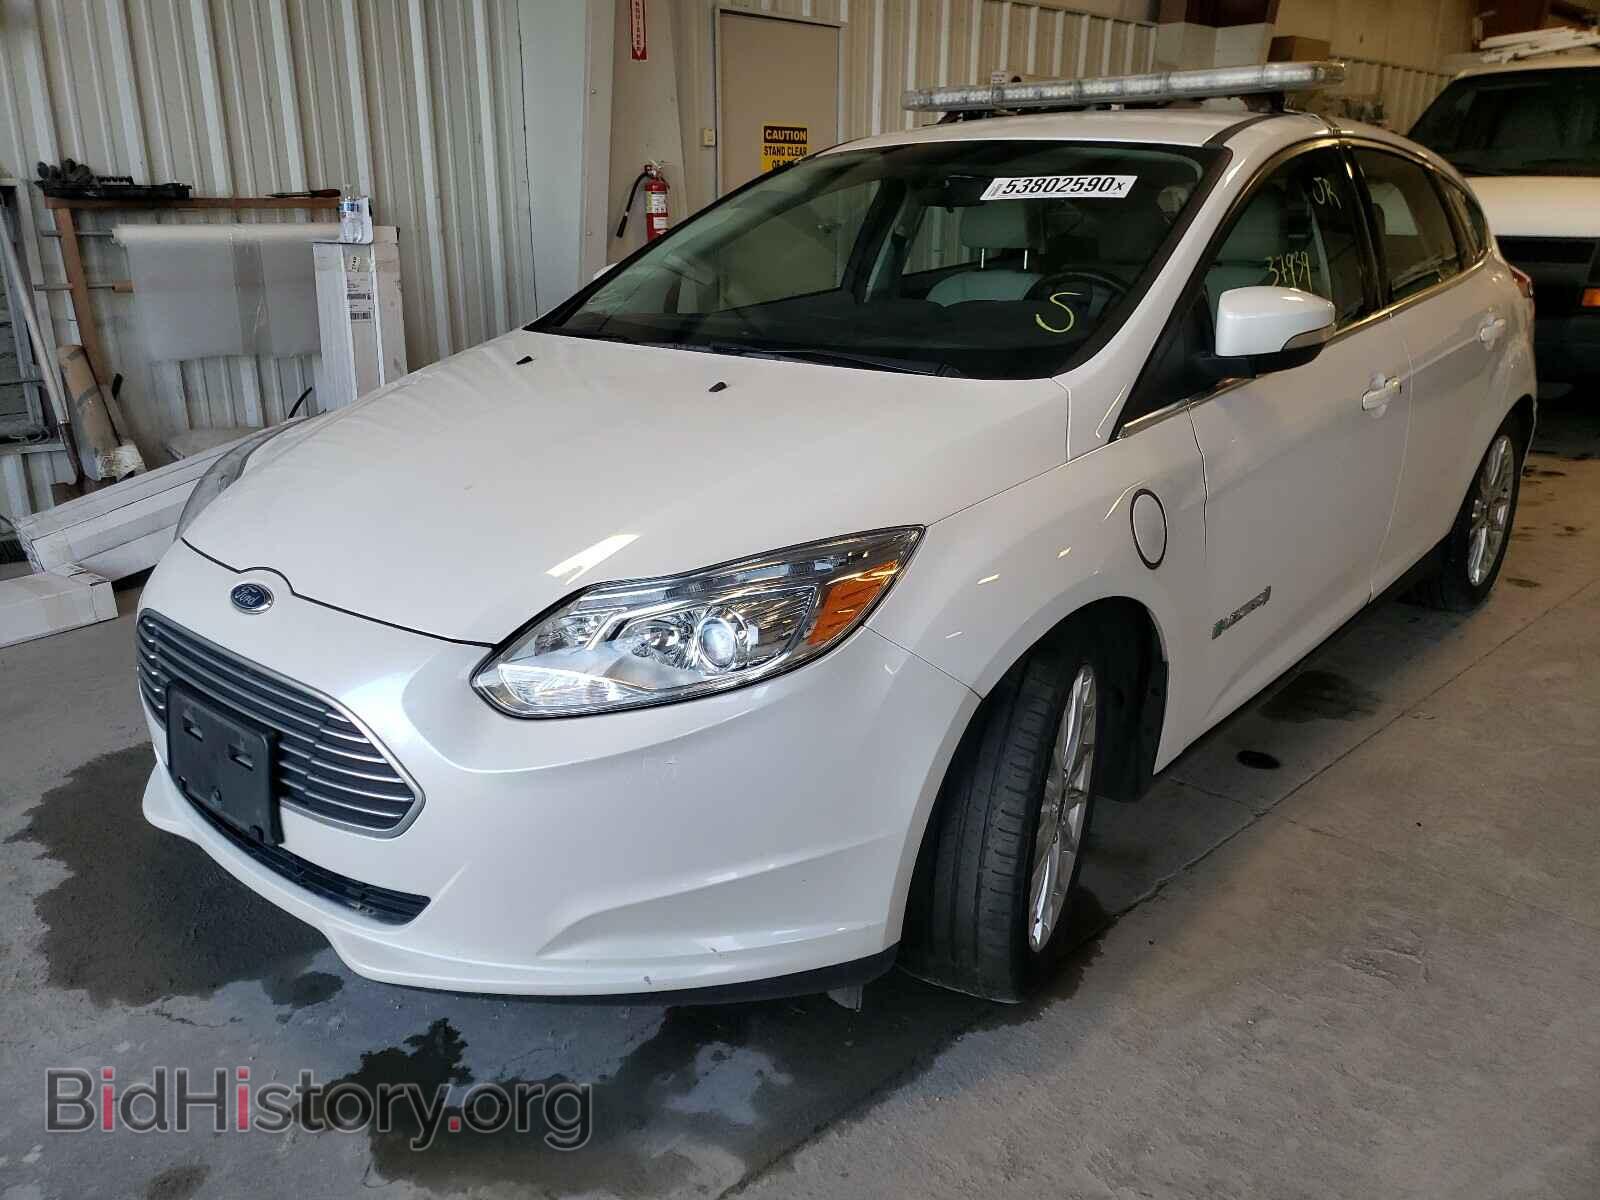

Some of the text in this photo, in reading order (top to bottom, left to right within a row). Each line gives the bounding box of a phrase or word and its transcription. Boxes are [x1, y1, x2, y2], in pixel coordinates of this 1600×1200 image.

[765, 129, 807, 140] CAUTION
[764, 145, 808, 157] STAND CLEAR
[234, 586, 262, 606] Ford
